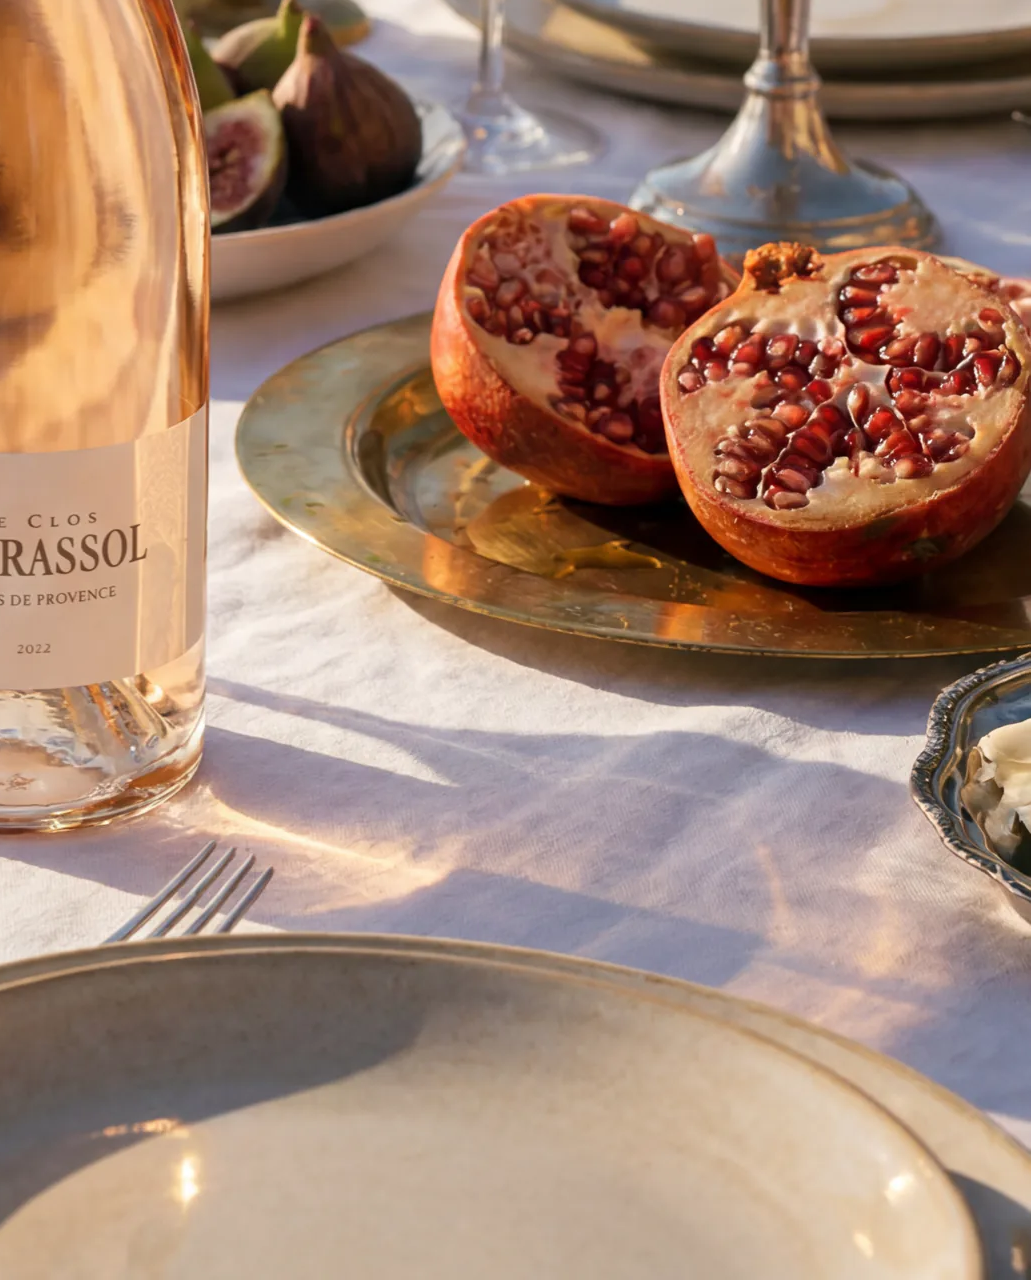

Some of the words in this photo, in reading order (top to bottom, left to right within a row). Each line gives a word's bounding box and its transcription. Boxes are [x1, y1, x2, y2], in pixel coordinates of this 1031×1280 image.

[27, 512, 98, 528] CLOS
[10, 595, 31, 606] DE
[37, 586, 117, 606] PROVENCE
[17, 643, 51, 654] 2022
